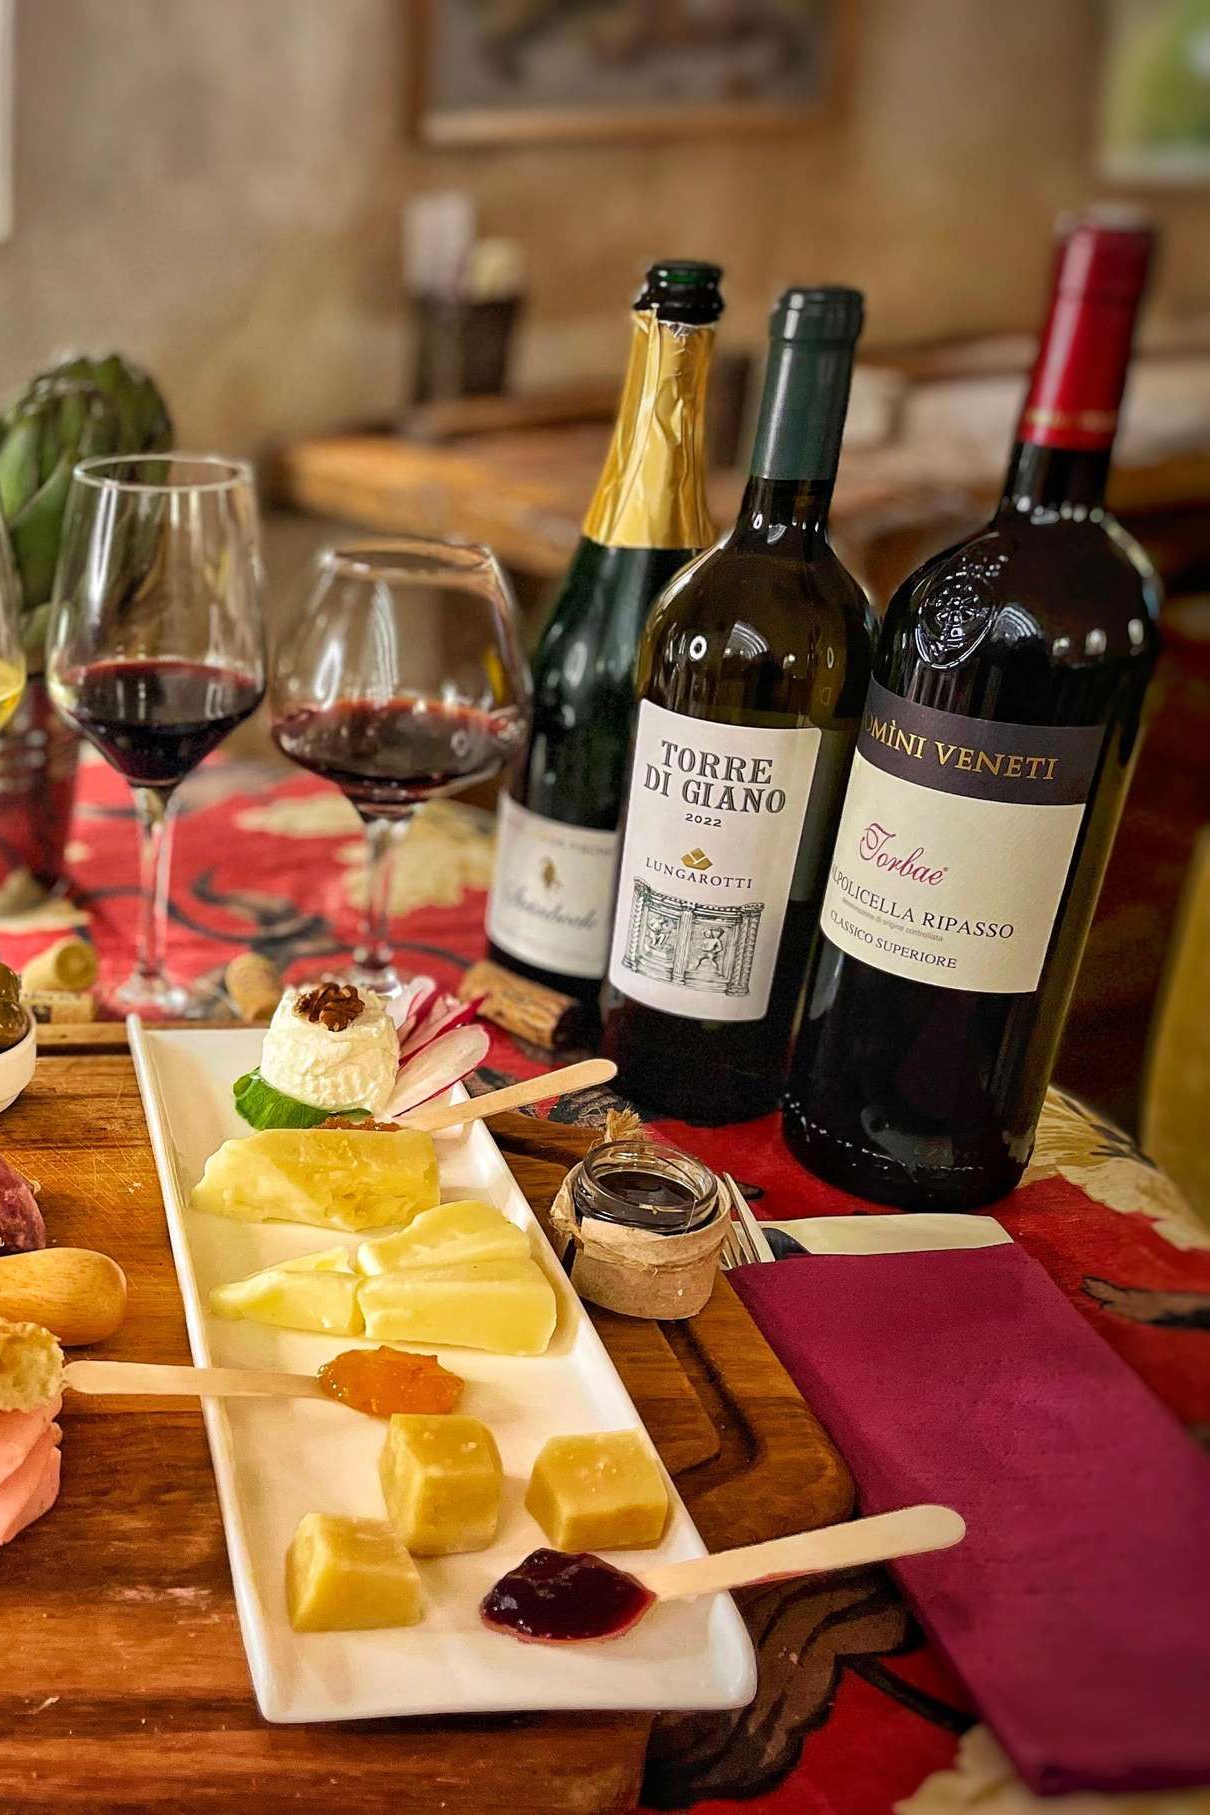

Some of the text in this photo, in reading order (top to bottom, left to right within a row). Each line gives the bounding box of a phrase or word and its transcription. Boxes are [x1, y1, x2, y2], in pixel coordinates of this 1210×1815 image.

[661, 739, 774, 785] TORRE
[862, 711, 1059, 780] OMÌNI VENETI
[644, 763, 787, 814] DI GIANO
[685, 813, 722, 827] 2022
[646, 857, 754, 889] LUNGAROTTI
[831, 910, 958, 969] CLASSICO SUPERIORE
[922, 911, 1014, 939] RIPASSO
